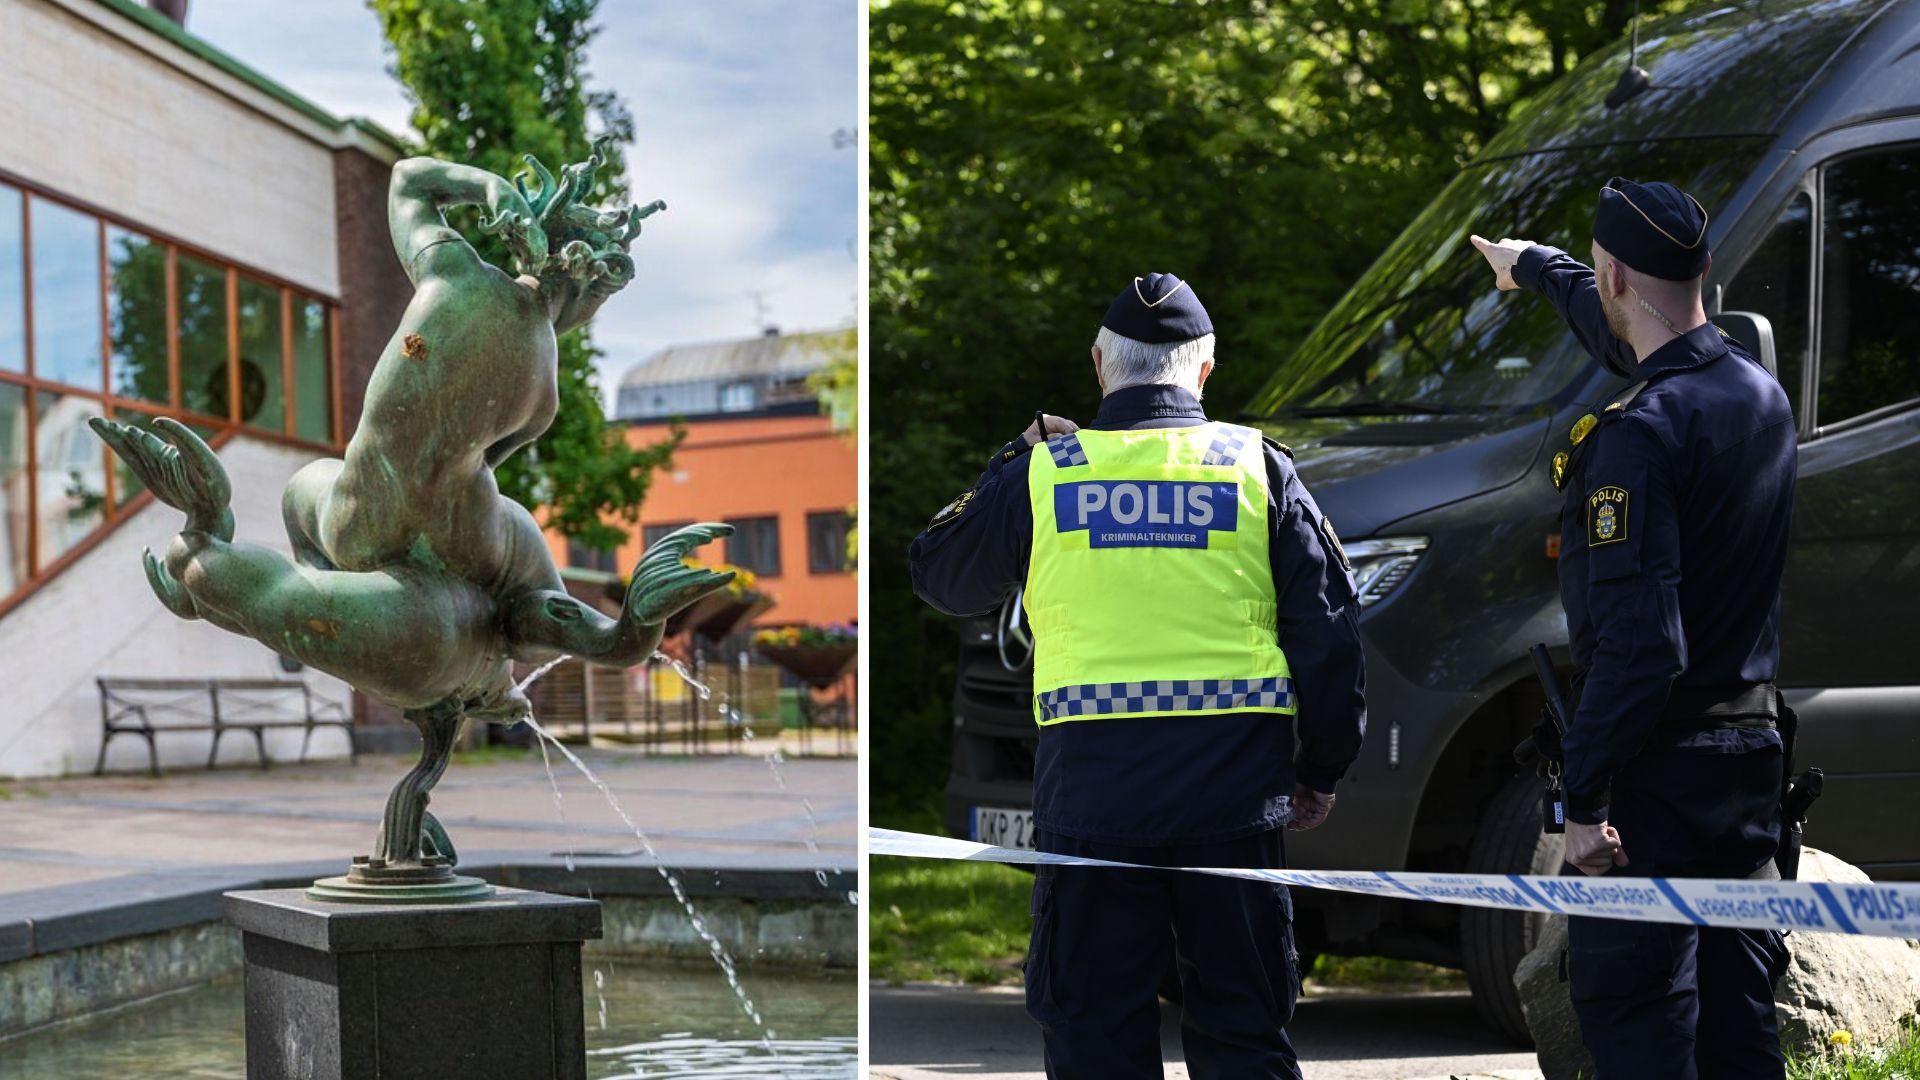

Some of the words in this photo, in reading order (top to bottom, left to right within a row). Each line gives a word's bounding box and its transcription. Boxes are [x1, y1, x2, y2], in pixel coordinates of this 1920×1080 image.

[1077, 482, 1214, 526] POLIS
[1592, 489, 1625, 508] POLIS
[1101, 532, 1197, 543] KRIMINALTEKNIKER
[1537, 880, 1595, 905] POLIS
[1844, 887, 1905, 921] POLIS
[1766, 897, 1825, 928] POLIS
